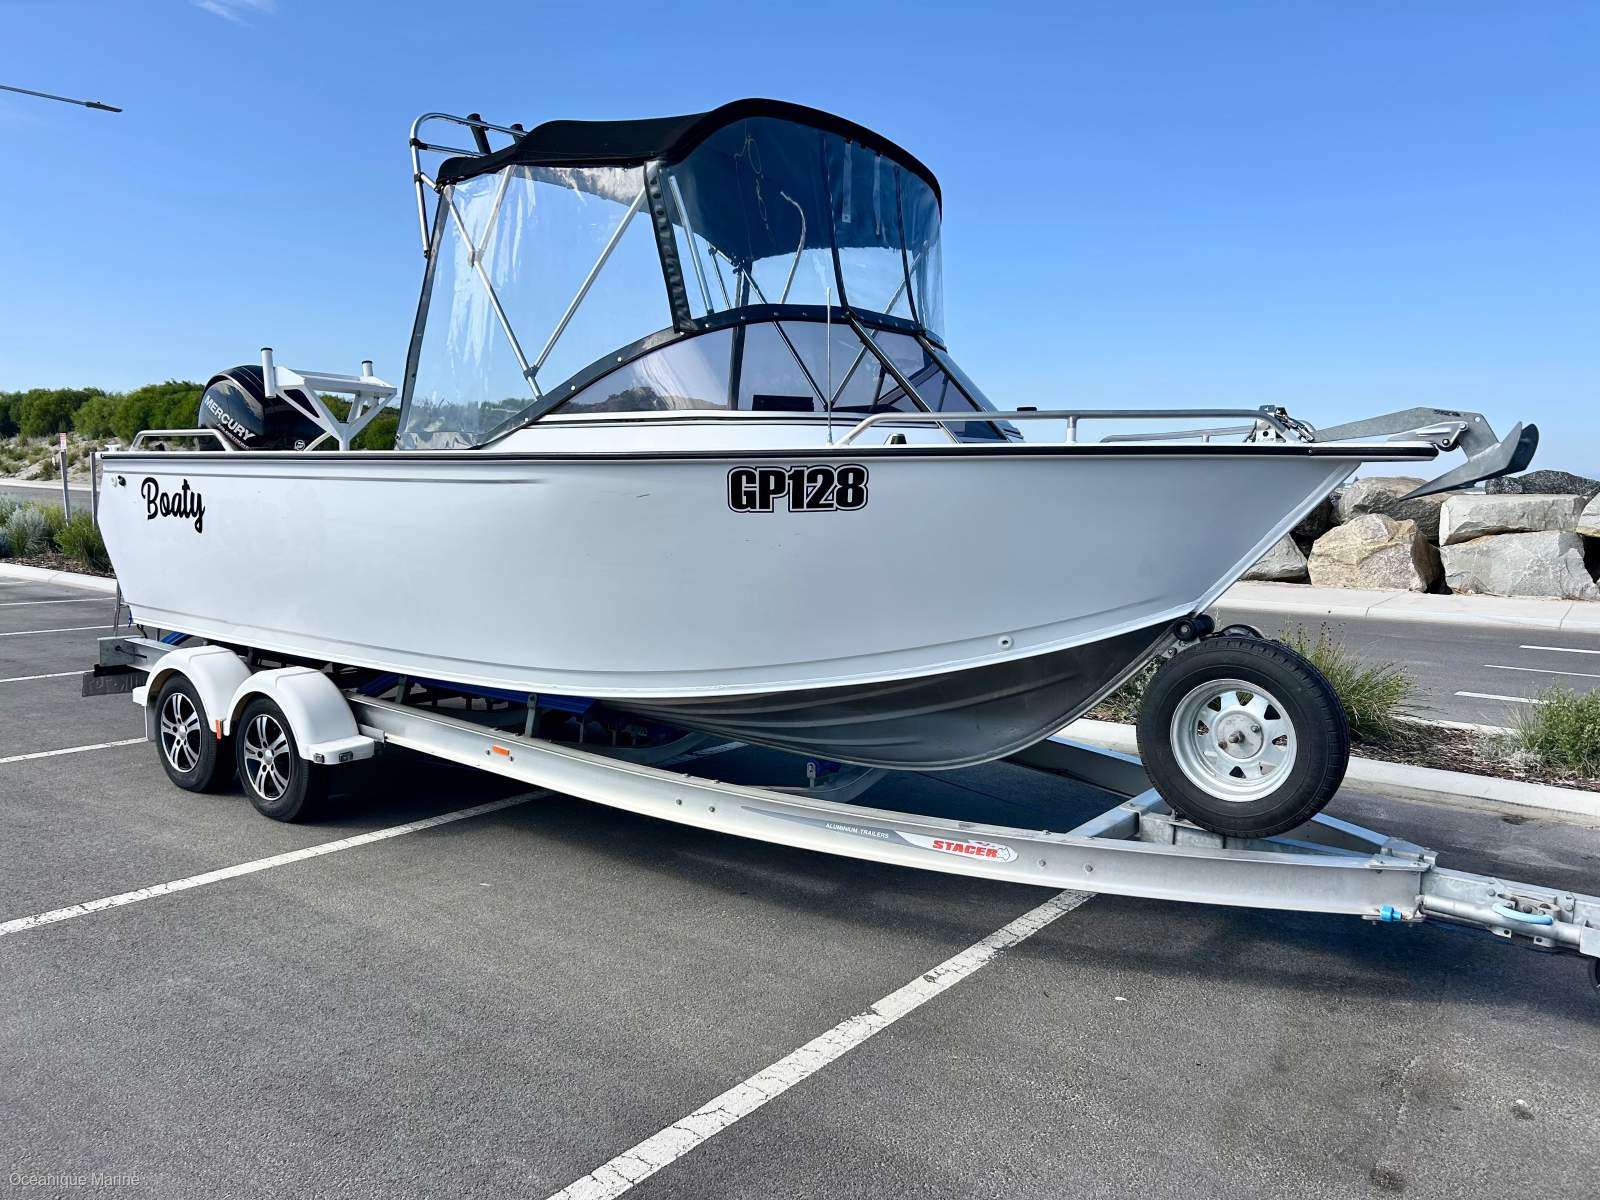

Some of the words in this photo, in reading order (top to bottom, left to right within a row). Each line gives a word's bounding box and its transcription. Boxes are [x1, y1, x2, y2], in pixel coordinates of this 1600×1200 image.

[204, 395, 256, 441] MERCURY
[141, 476, 206, 534] Boaty
[727, 464, 869, 513] GP128
[825, 823, 858, 834] ALUMINIUM
[860, 828, 889, 839] TRAILERS
[932, 839, 998, 858] STACER
